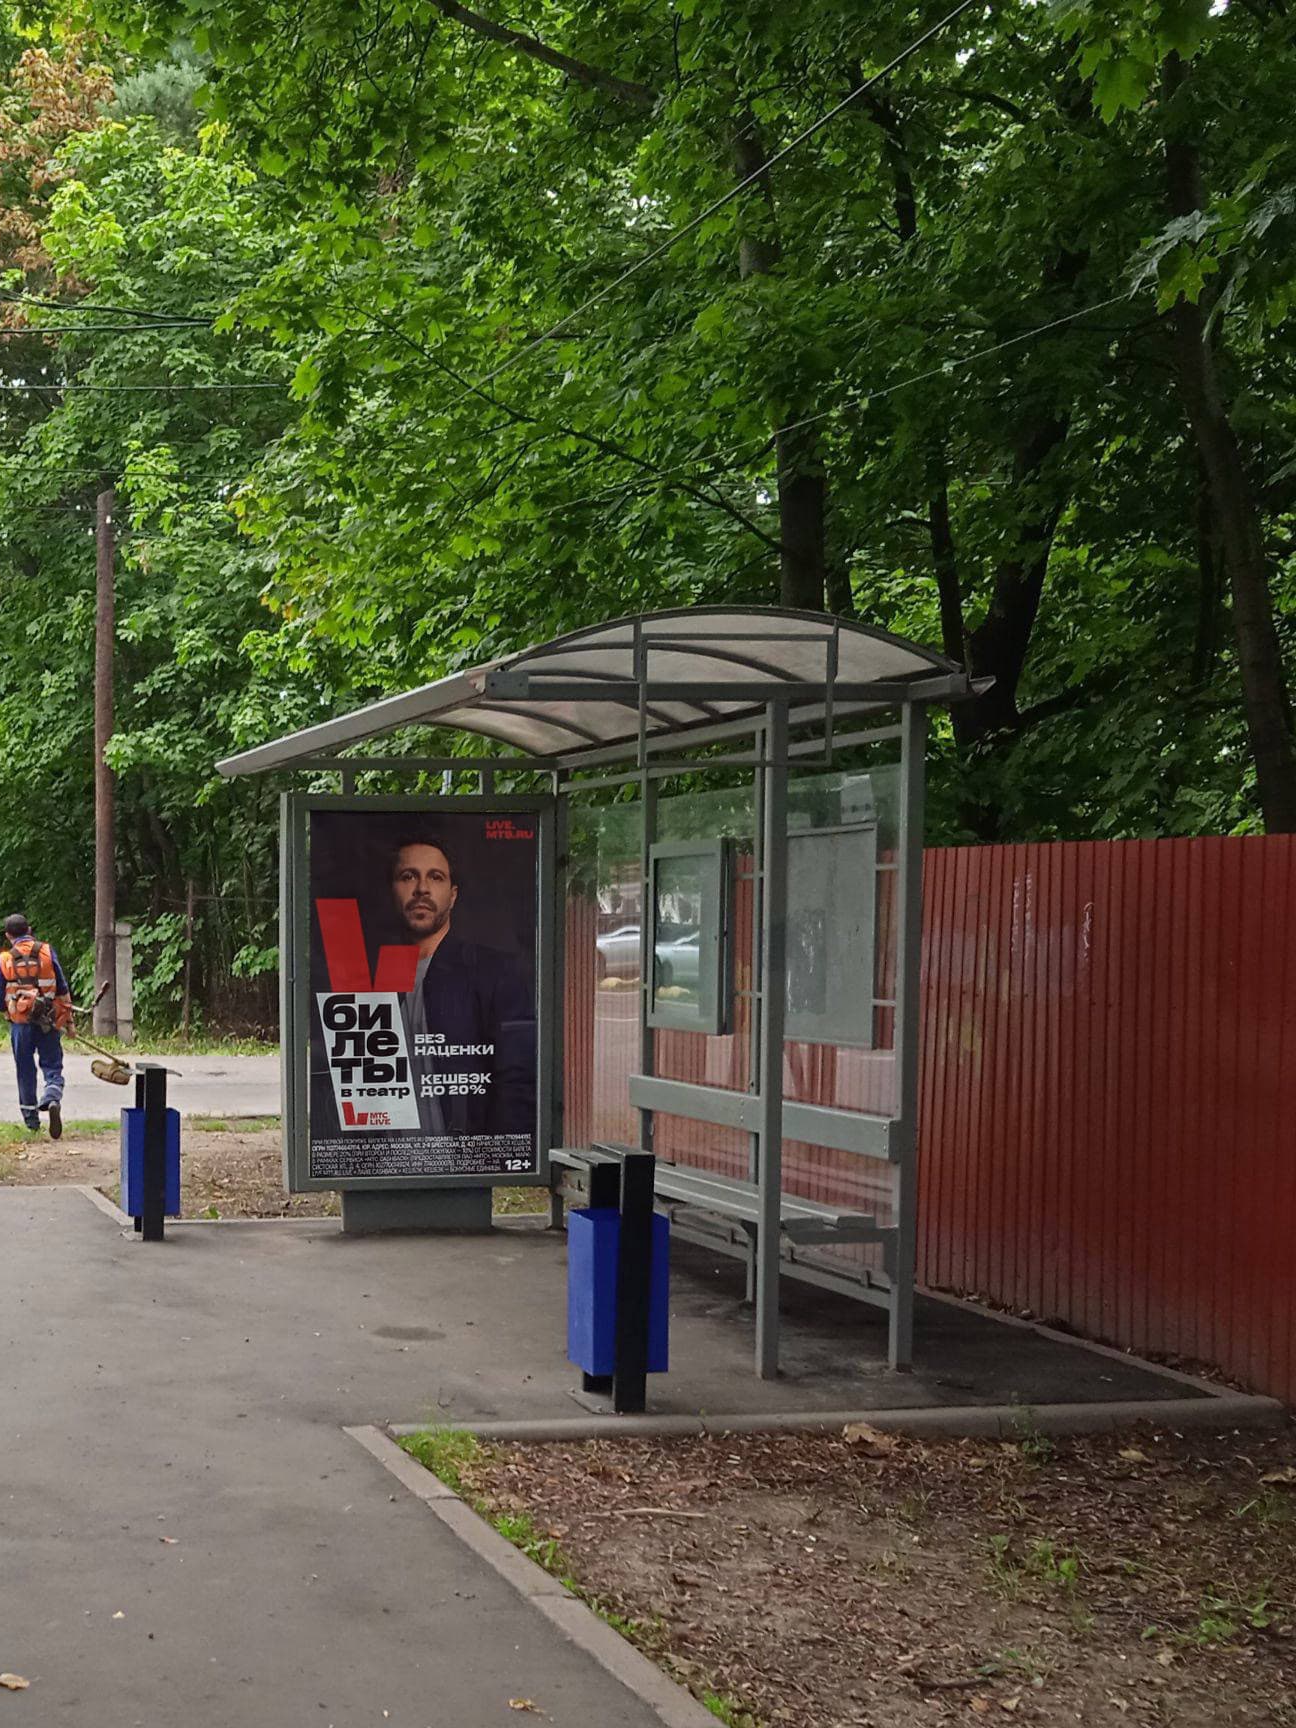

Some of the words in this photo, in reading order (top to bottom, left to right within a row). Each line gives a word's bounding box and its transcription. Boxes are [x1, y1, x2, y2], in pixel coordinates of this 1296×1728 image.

[414, 1033, 445, 1044] БЕЗ
[414, 1045, 494, 1057] НАЦЕНКИ
[420, 1073, 492, 1085] КЕШБЭК
[341, 1088, 352, 1098] в
[356, 1087, 410, 1099] театр
[420, 1085, 445, 1098] ДО
[448, 1084, 486, 1095] 20%
[504, 1160, 532, 1171] 12+
